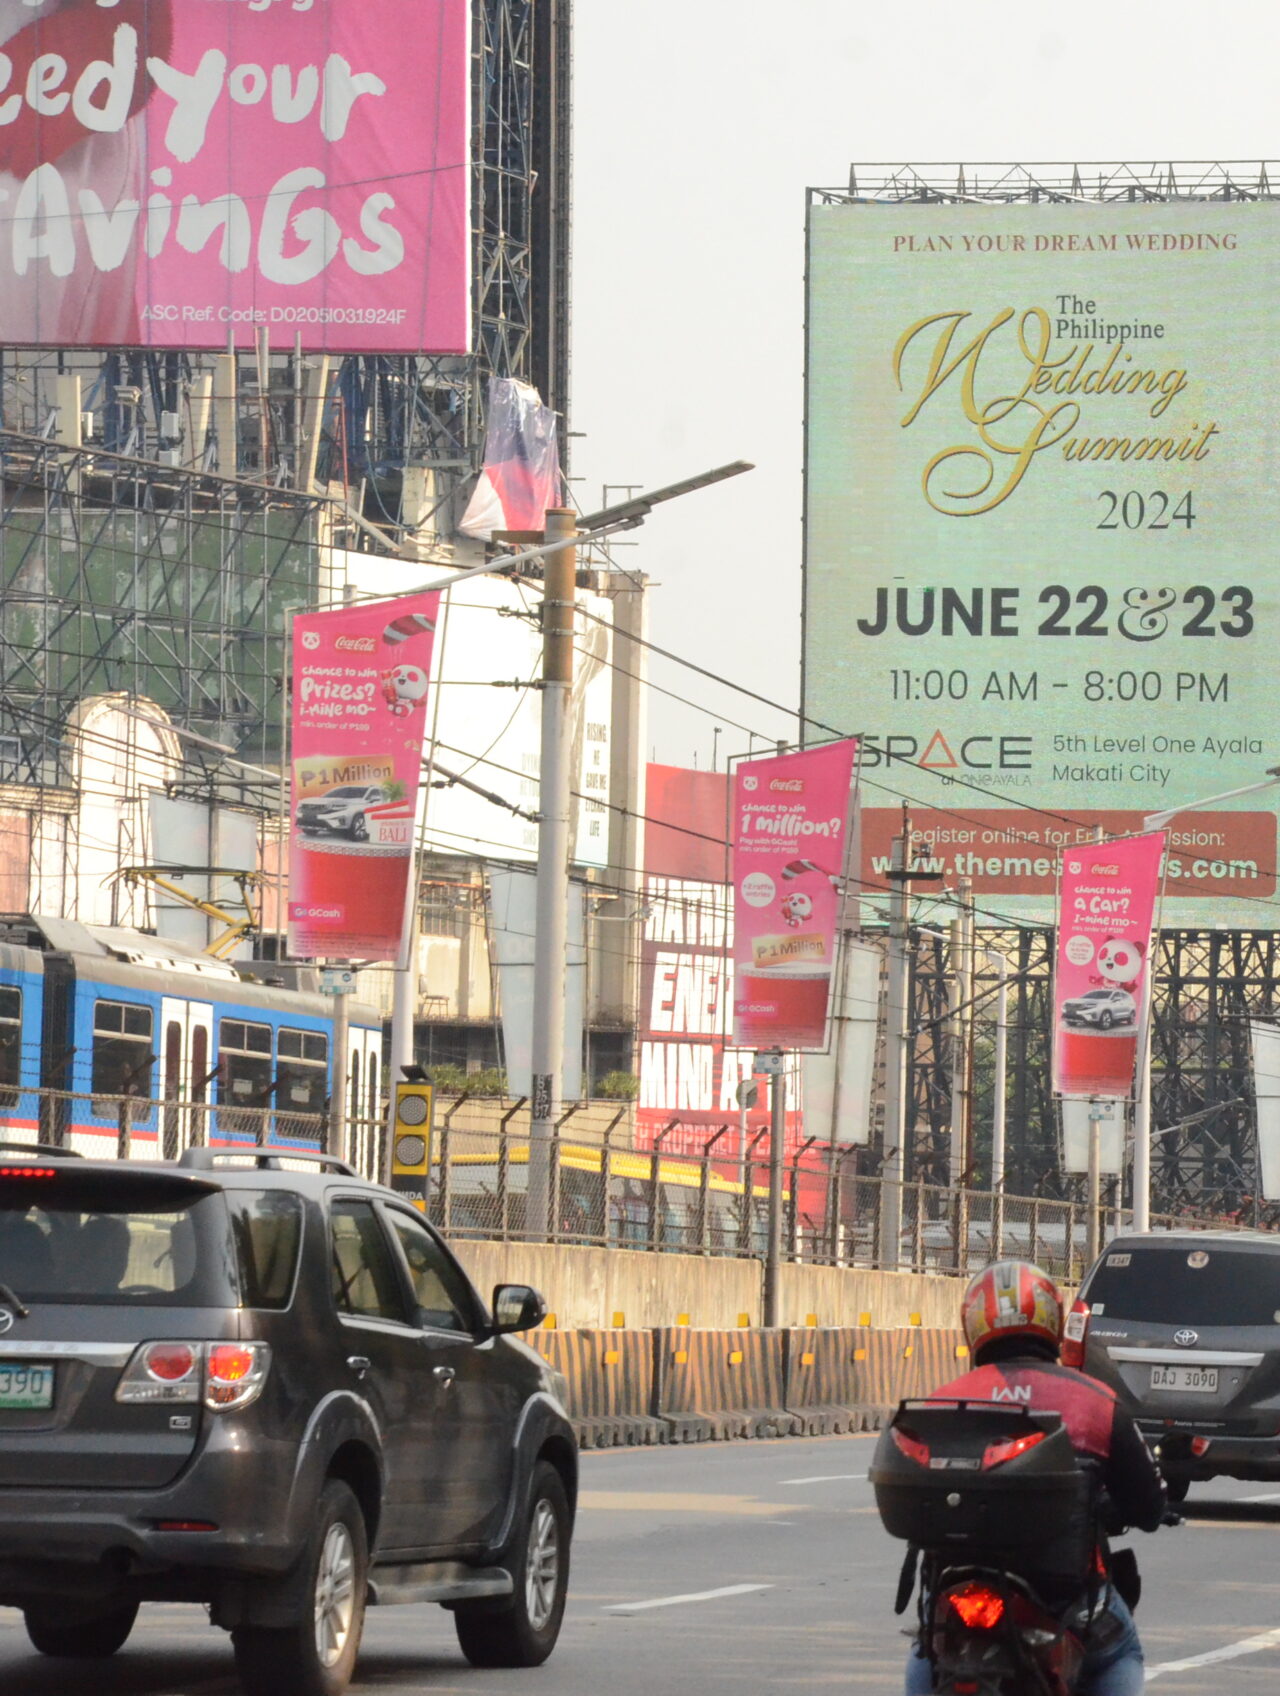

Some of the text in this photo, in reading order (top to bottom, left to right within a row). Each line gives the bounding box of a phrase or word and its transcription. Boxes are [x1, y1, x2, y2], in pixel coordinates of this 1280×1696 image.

[893, 233, 1237, 252] PLAN YOUR DREAM WEDDING
[140, 305, 178, 321] ASC
[182, 306, 214, 321] Ref.
[218, 306, 267, 322] Code:
[1056, 295, 1096, 315] The
[1055, 318, 1165, 343] Philippine
[892, 306, 1188, 427] Wedding
[921, 397, 1219, 517] Summit
[1097, 490, 1196, 530] 2024
[857, 585, 1254, 642] JUNE 22 & 23
[301, 677, 376, 702] Prizes?
[890, 670, 968, 701] 11:00
[981, 671, 1038, 701] AM
[1083, 670, 1162, 702] 8:00
[1176, 672, 1229, 702] PM
[1053, 735, 1263, 759] 5th Level One Ayala
[333, 764, 392, 784] Million
[1052, 764, 1171, 788] Makati City
[379, 827, 408, 843] BALI
[756, 814, 842, 838] million?
[901, 826, 976, 848] egister
[981, 827, 1039, 844] online
[1045, 828, 1071, 844] for
[640, 1042, 713, 1110] MIND
[1153, 1371, 1216, 1387] DAJ 3090
